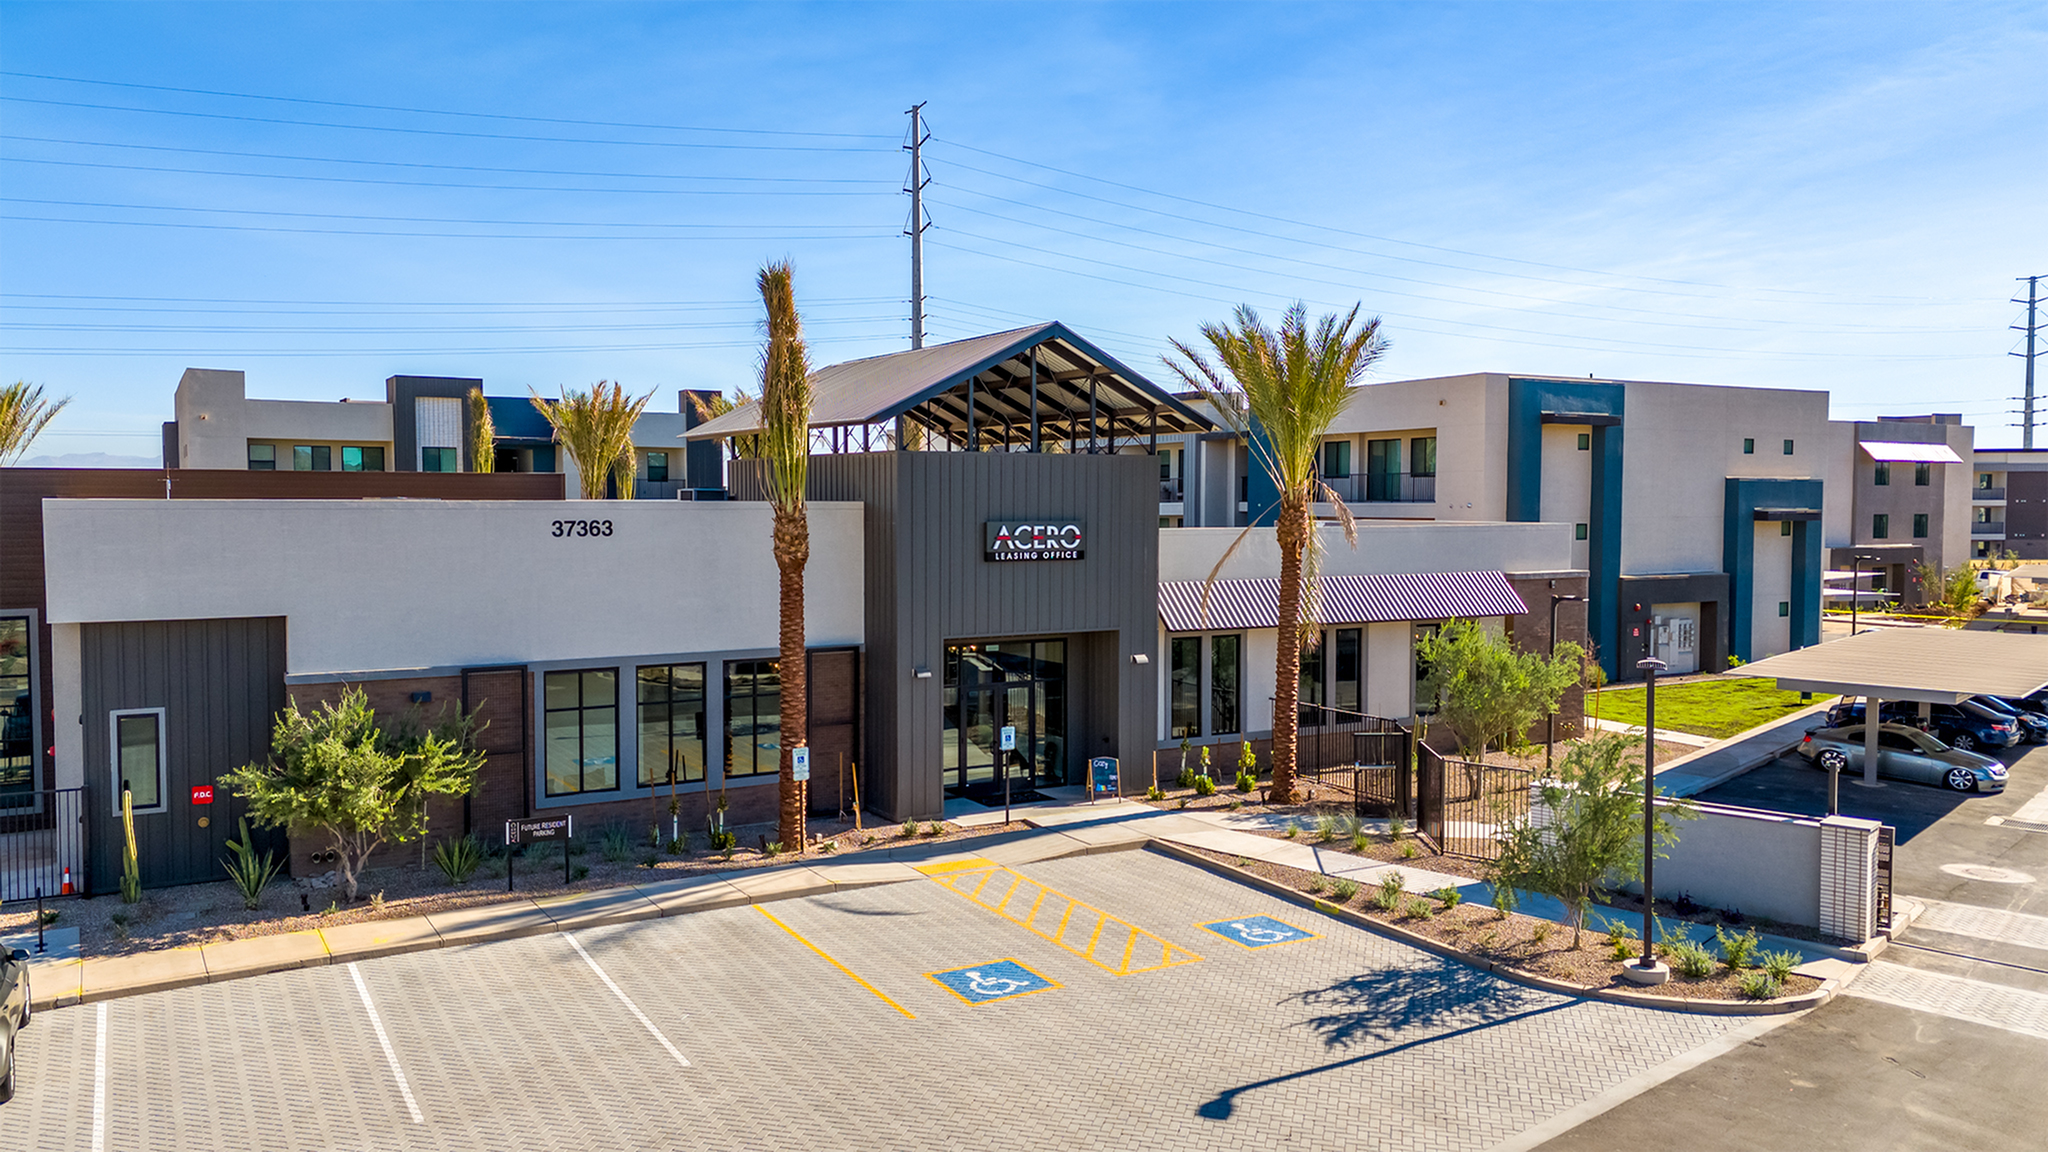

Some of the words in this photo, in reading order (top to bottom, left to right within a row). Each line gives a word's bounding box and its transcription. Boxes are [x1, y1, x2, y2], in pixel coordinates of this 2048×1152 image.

[551, 519, 613, 537] 37363
[992, 524, 1082, 550] ACERO
[995, 552, 1038, 561] LEASING
[1042, 551, 1078, 560] OFFICE
[521, 822, 541, 831] FUTURE
[541, 819, 566, 829] RESIDENT
[532, 828, 555, 837] PARKING
